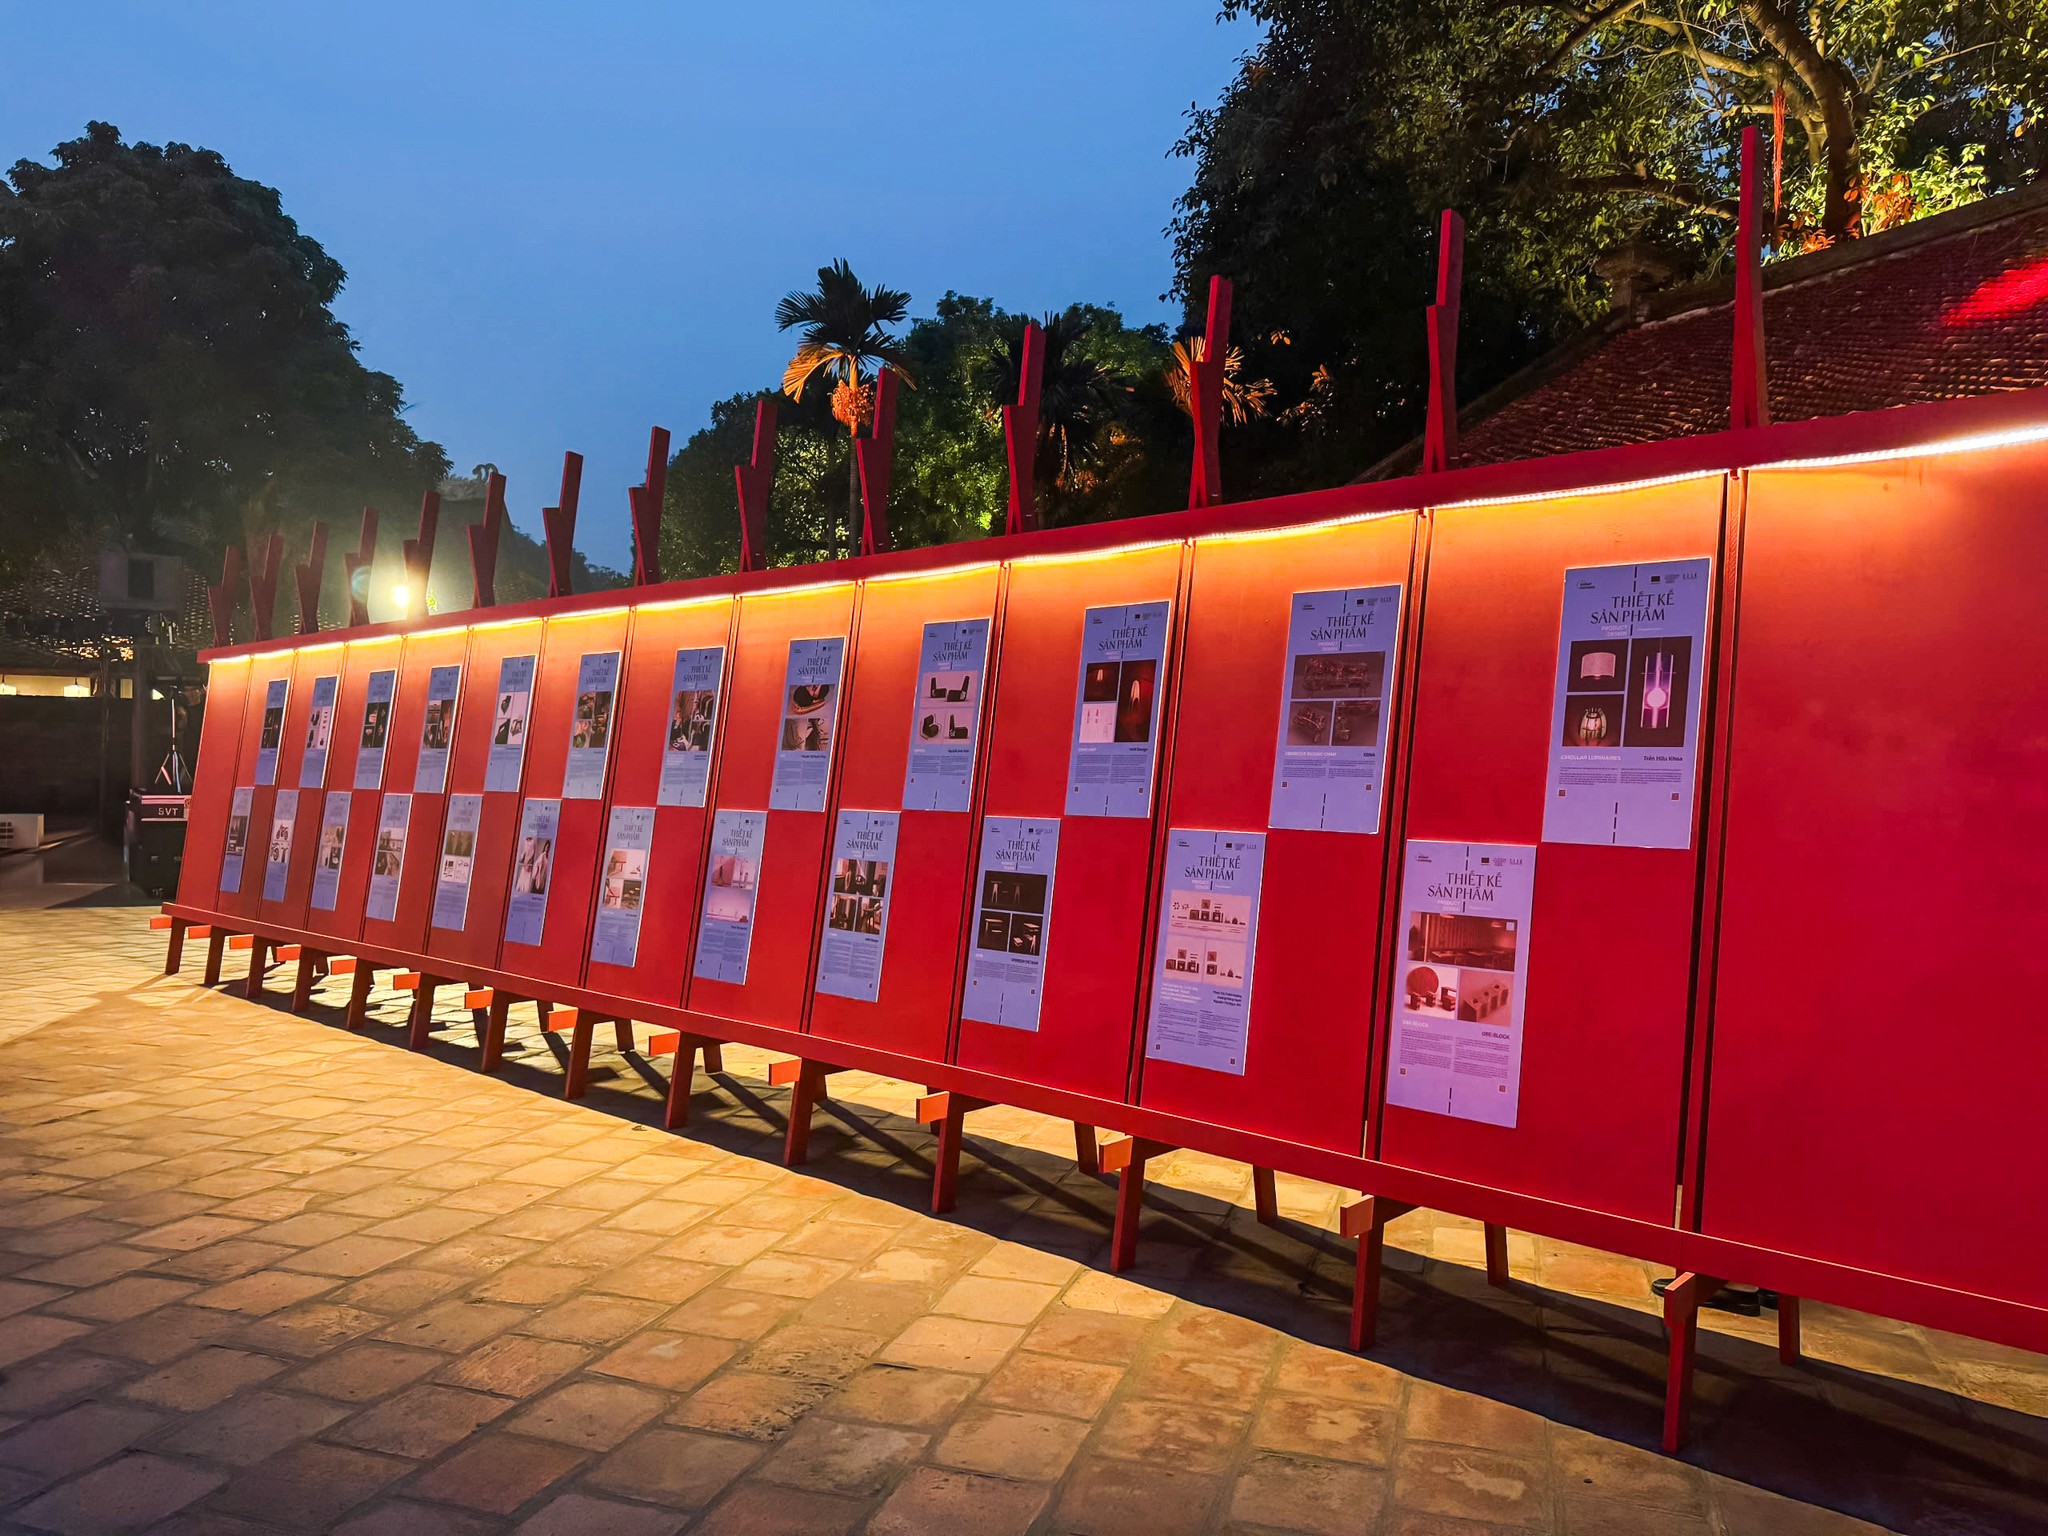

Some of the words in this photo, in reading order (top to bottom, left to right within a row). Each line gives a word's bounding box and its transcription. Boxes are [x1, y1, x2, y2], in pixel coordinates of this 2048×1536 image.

[1612, 589, 1654, 608] THIẾT
[1657, 588, 1674, 606] KẾ
[1327, 612, 1359, 627] THIẾT
[1361, 610, 1374, 625] KẾ
[1590, 609, 1618, 624] SẢN
[1622, 607, 1665, 622] PHẨM
[1310, 628, 1333, 640] SẢN
[1334, 625, 1366, 640] PHẨM
[158, 807, 178, 816] SVT
[1446, 870, 1484, 887] THIẾT
[1487, 872, 1502, 888] KẾ
[1428, 883, 1453, 898] SẢN
[1456, 886, 1494, 901] PHẨM
